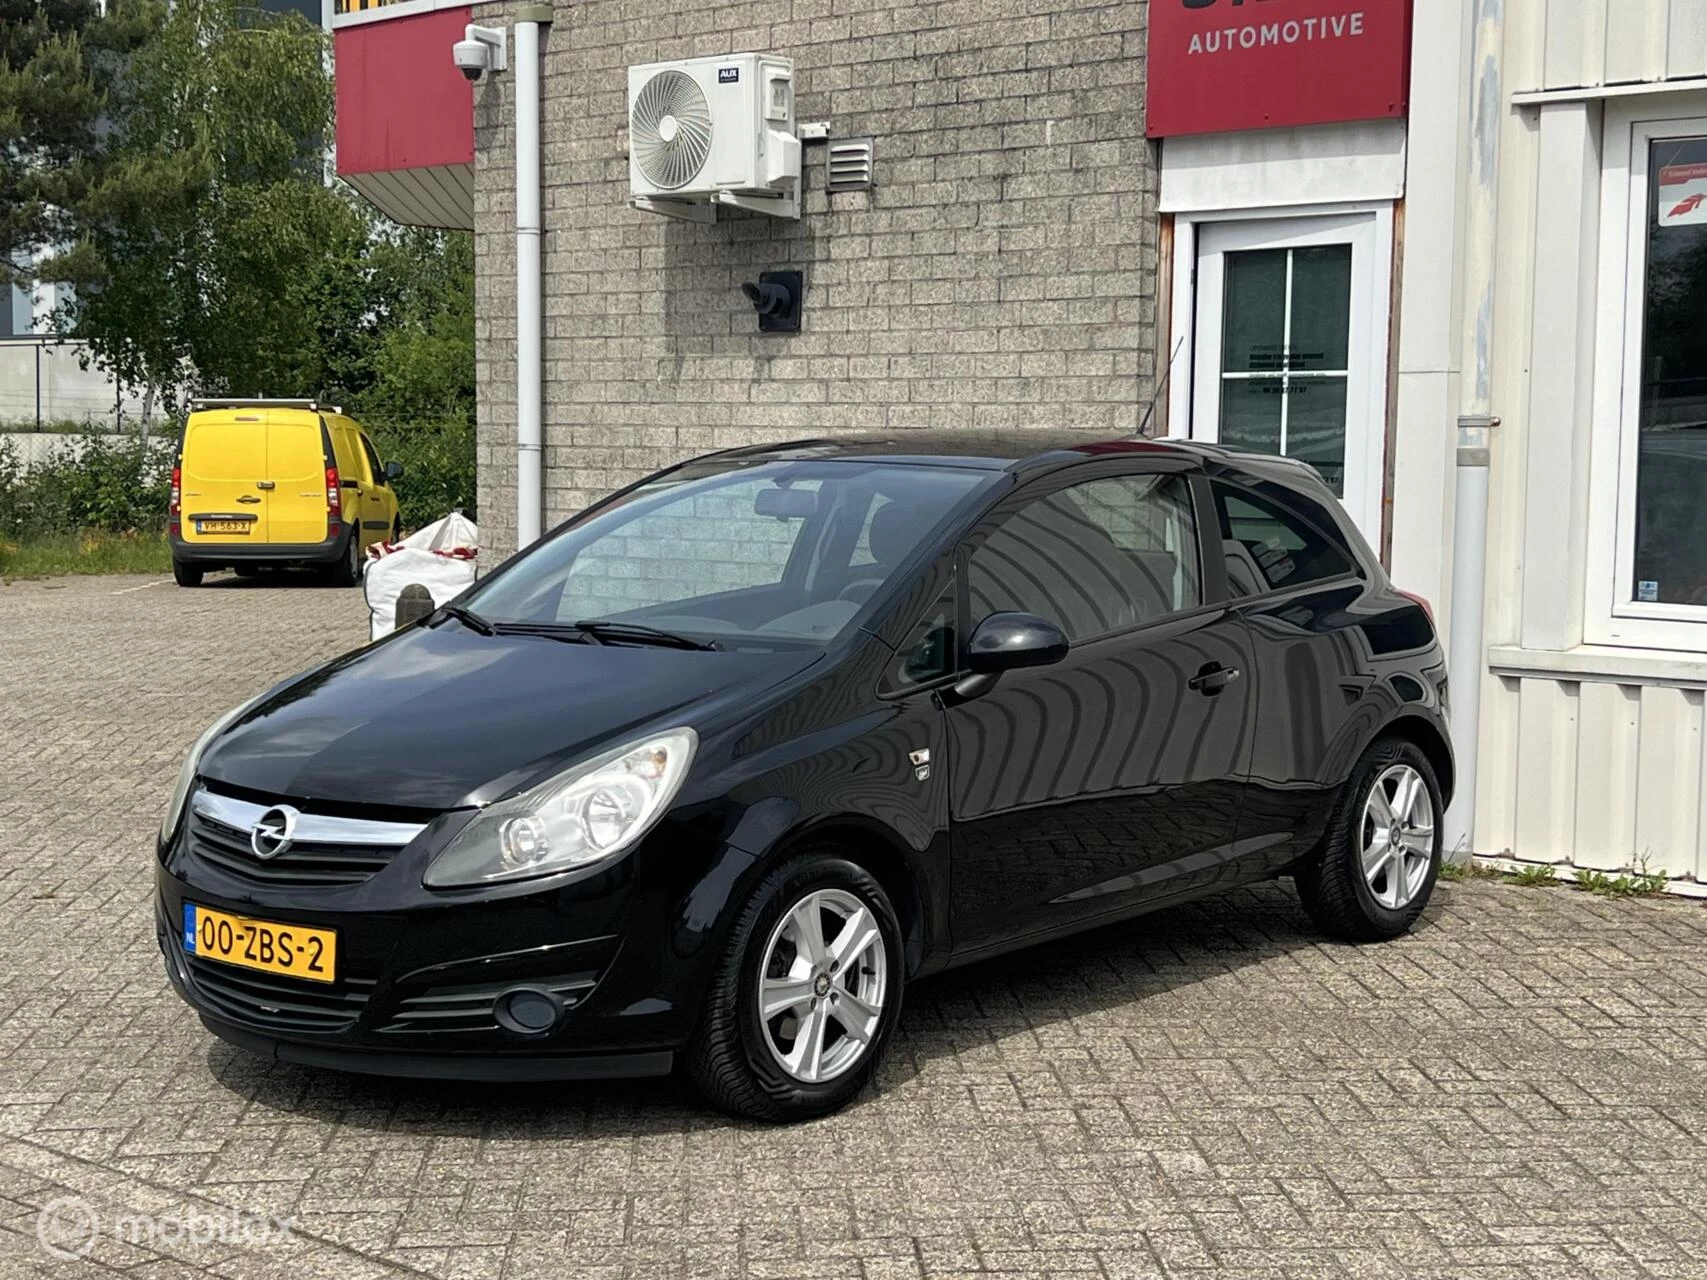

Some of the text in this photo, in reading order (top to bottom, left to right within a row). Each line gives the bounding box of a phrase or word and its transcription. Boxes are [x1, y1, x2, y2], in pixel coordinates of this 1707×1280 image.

[1188, 12, 1364, 54] AUTOMOTIVE
[186, 931, 196, 944] NL
[202, 915, 324, 972] 00-ZBS-2
